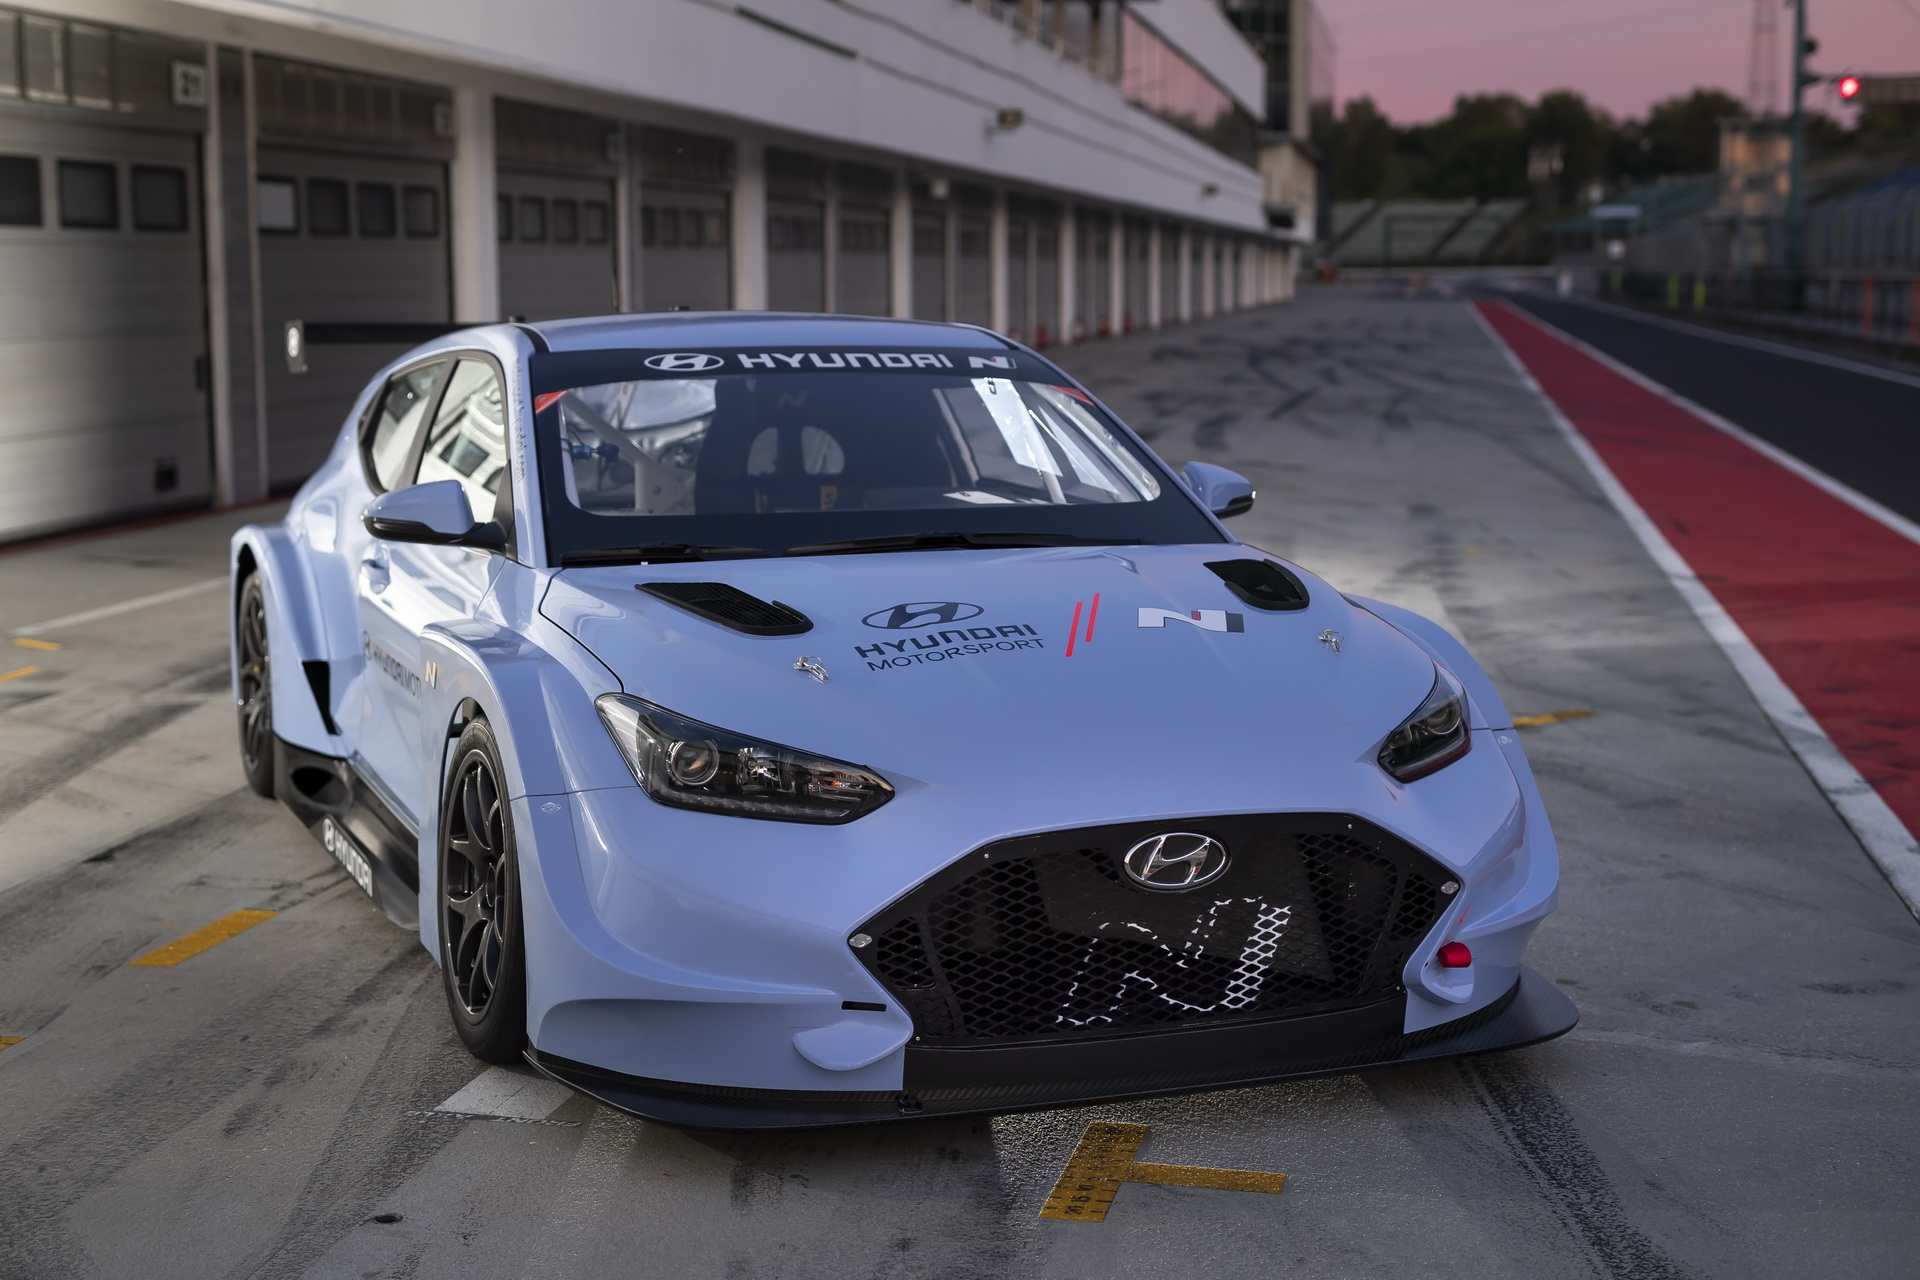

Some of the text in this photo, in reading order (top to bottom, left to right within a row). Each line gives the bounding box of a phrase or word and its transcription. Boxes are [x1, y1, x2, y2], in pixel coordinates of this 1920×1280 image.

[737, 353, 954, 368] HYUNDAI
[854, 624, 1039, 658] HYUNDAI
[866, 638, 1045, 671] MOTORSPORT
[335, 829, 373, 898] HYUNDAI
